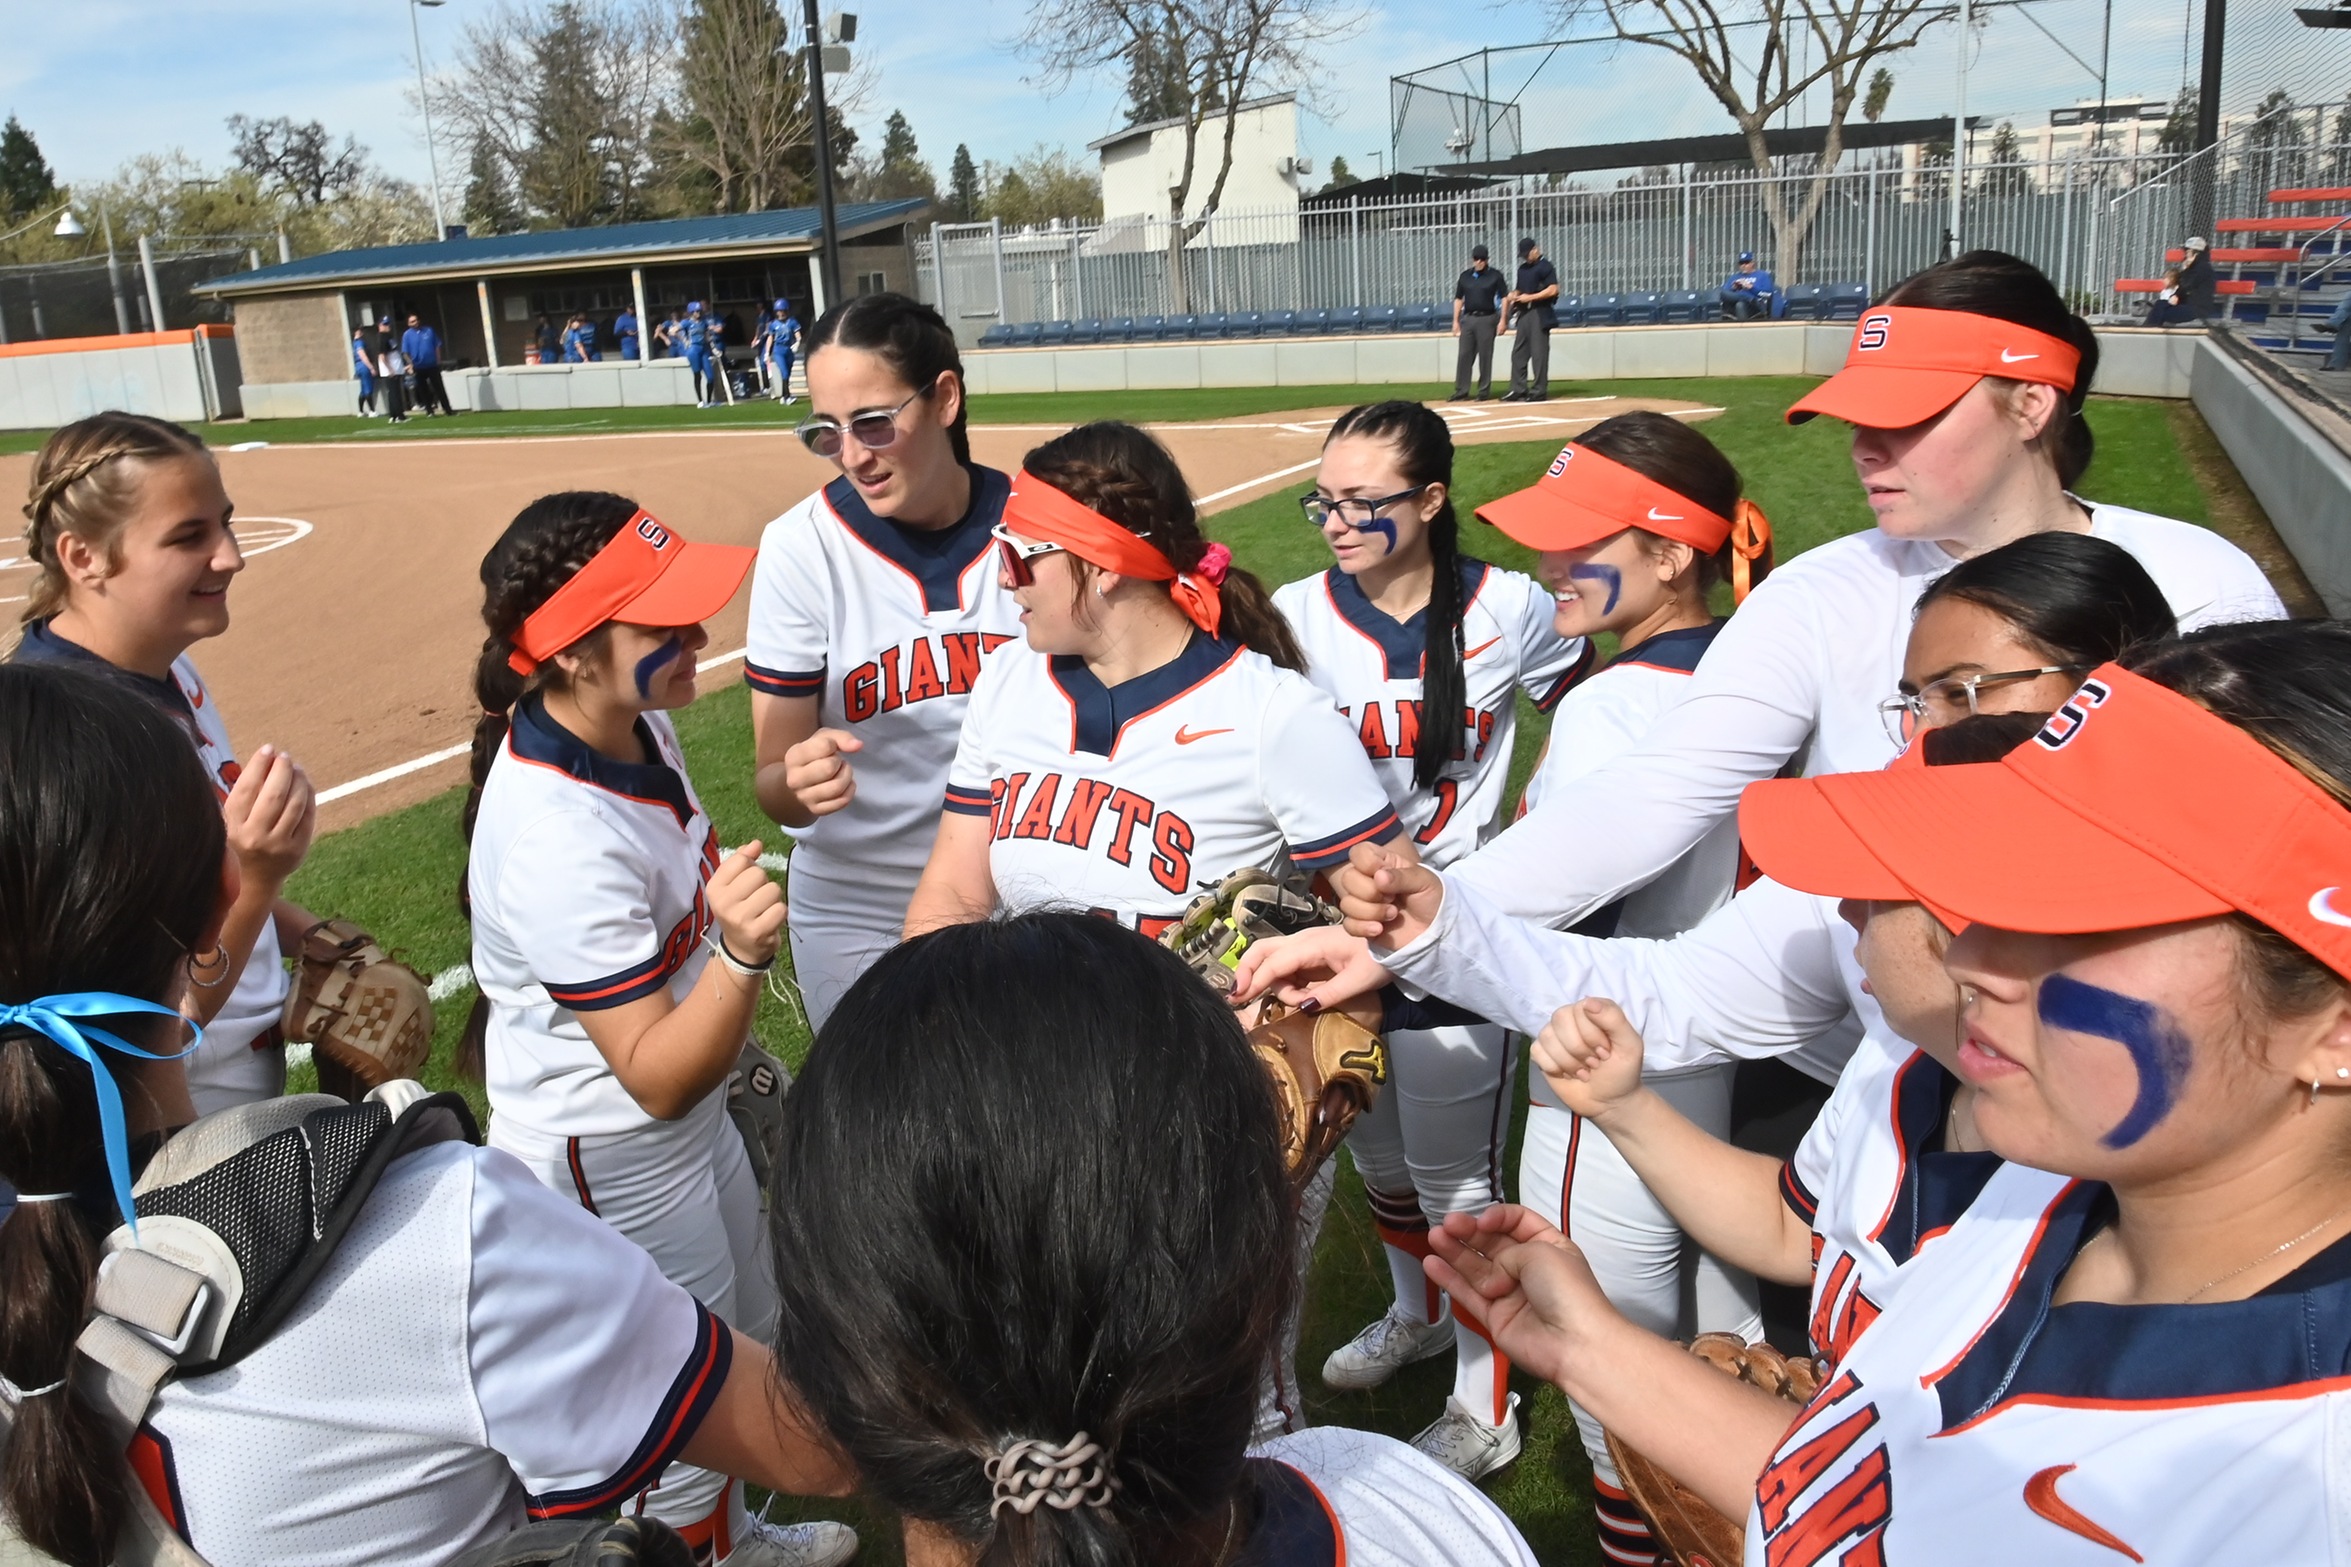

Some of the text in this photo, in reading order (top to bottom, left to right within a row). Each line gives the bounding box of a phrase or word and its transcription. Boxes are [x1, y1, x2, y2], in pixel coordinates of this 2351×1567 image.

[1858, 314, 1891, 352] S
[636, 516, 670, 552] S
[842, 631, 1019, 724] GIAN
[2032, 677, 2112, 752] S
